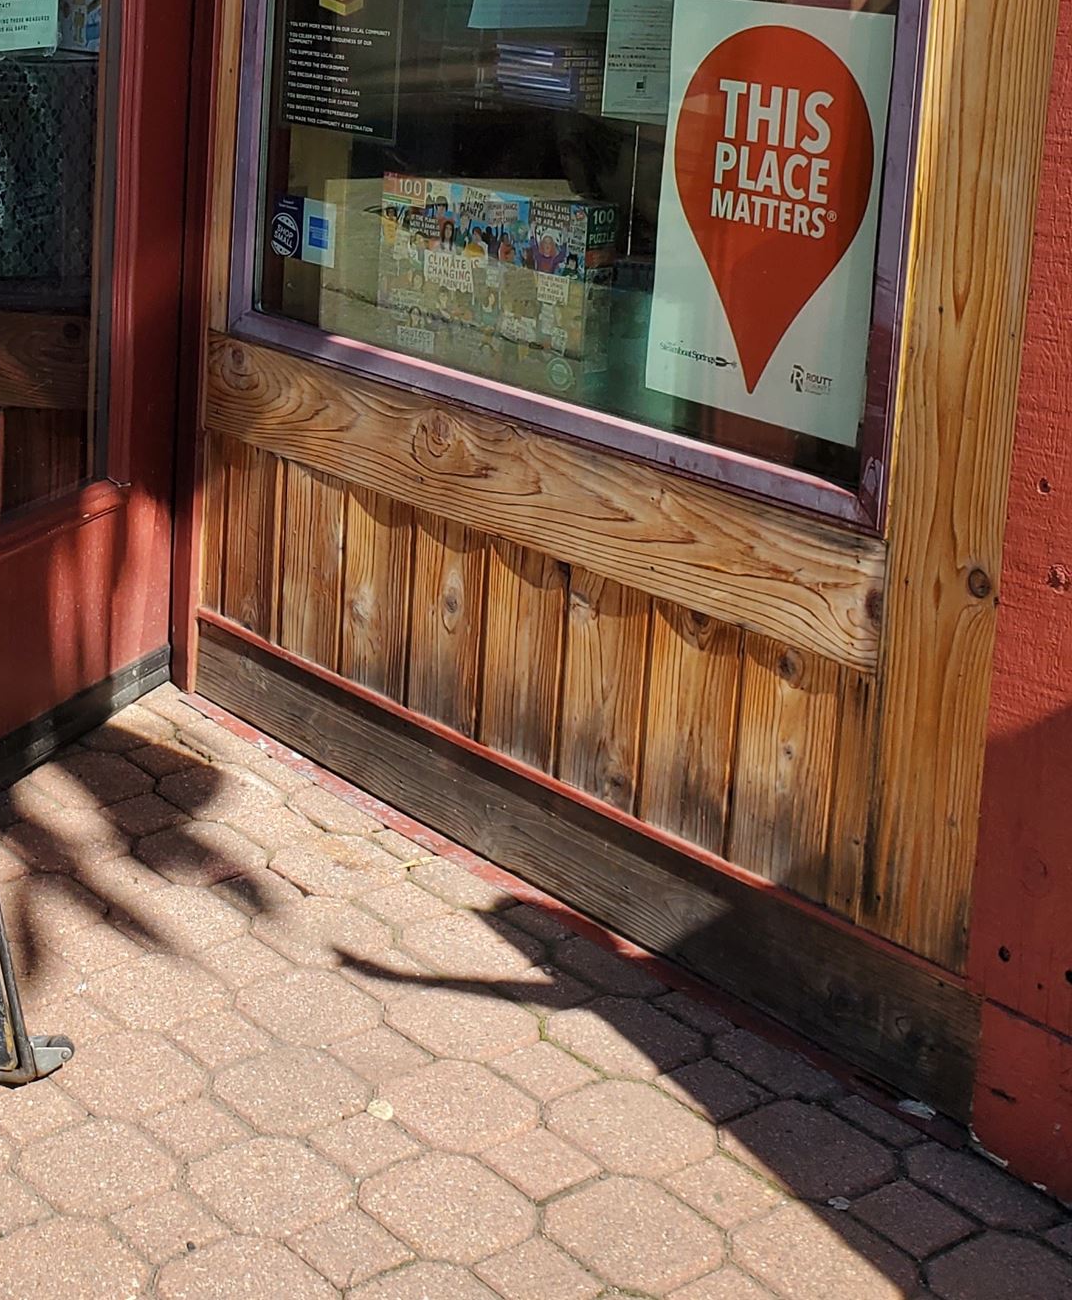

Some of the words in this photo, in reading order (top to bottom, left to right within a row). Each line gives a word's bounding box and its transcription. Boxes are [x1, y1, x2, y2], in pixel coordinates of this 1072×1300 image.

[719, 78, 835, 155] THIS
[713, 141, 830, 205] PLACE
[399, 179, 422, 196] 100
[543, 202, 553, 210] SEA
[554, 203, 569, 213] LEVEL
[593, 208, 615, 225] 100
[274, 230, 293, 248] SMALL
[278, 224, 294, 238] SHOP
[589, 232, 615, 245] PUZZLE
[428, 254, 466, 268] CLIMATE
[428, 265, 471, 282] CHANGING
[806, 372, 833, 386] ROUTT
